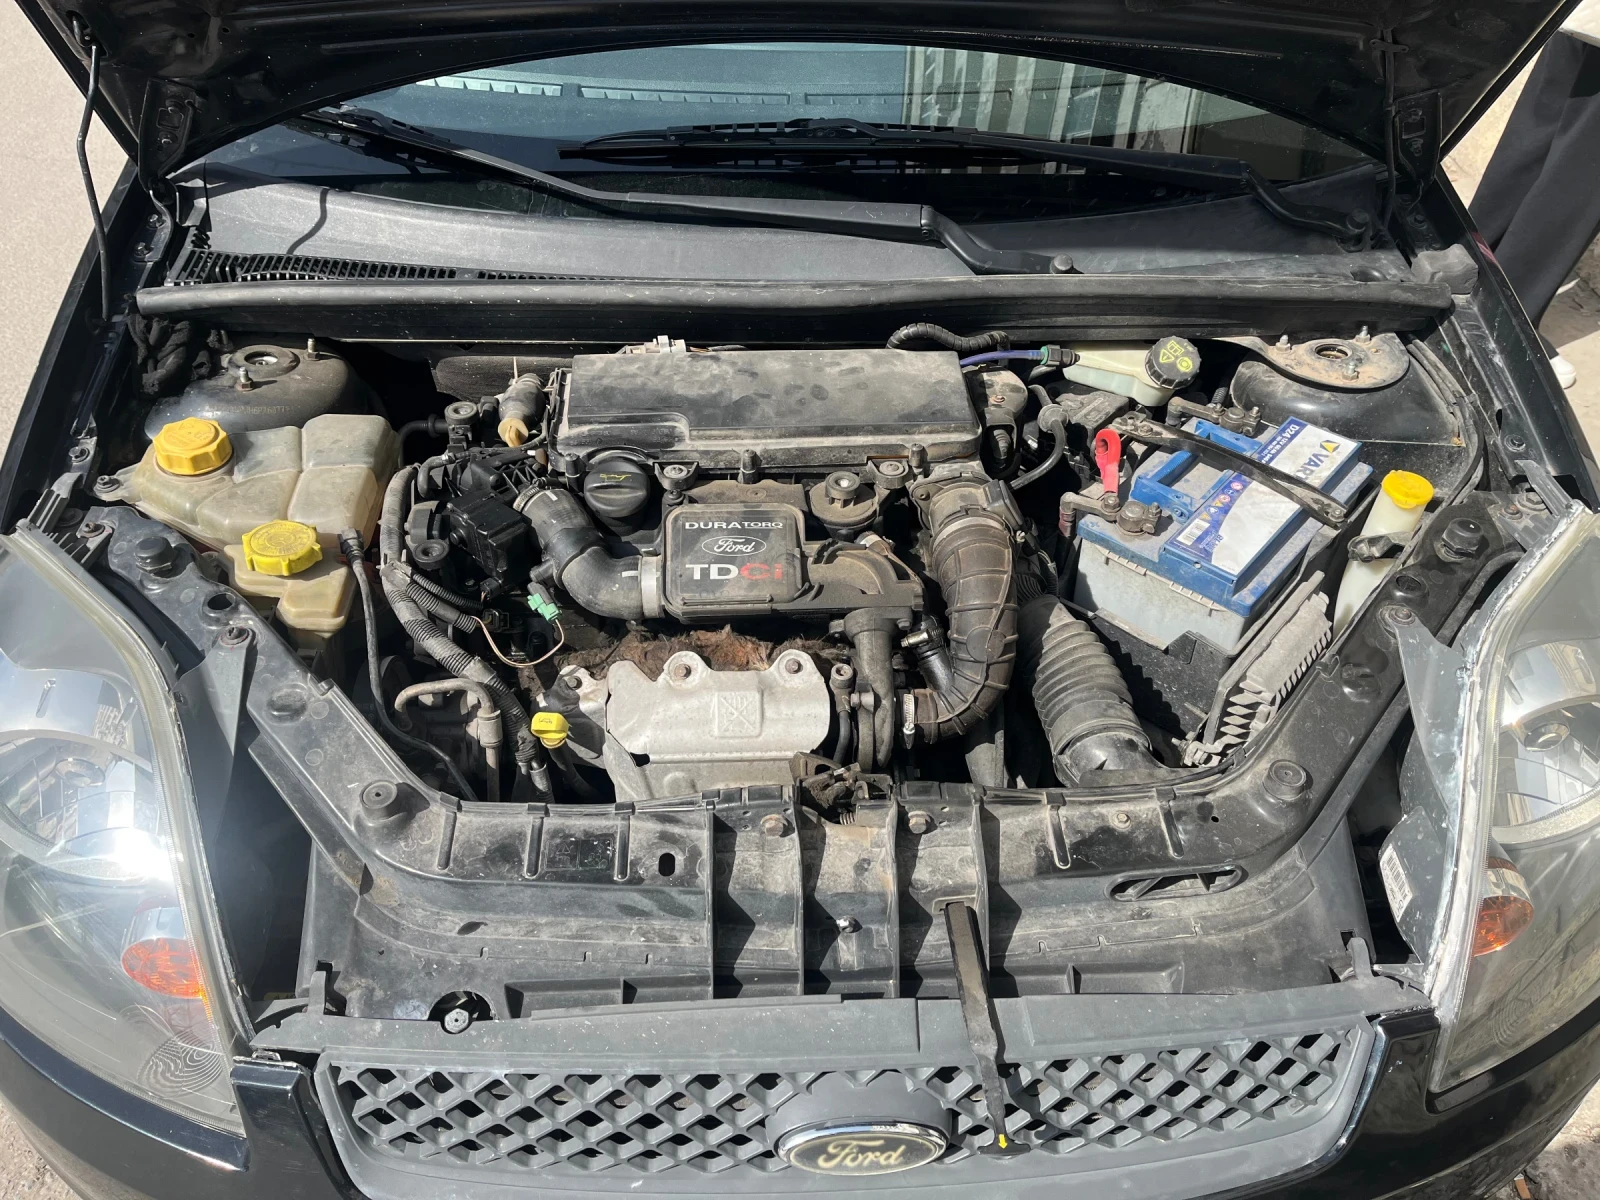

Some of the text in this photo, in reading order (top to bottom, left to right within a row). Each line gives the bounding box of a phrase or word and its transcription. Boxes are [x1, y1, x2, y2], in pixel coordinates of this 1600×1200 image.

[685, 521, 784, 530] DURATORQ
[714, 538, 755, 553] Ford
[685, 563, 783, 581] TDCi
[818, 1139, 906, 1169] Ford
